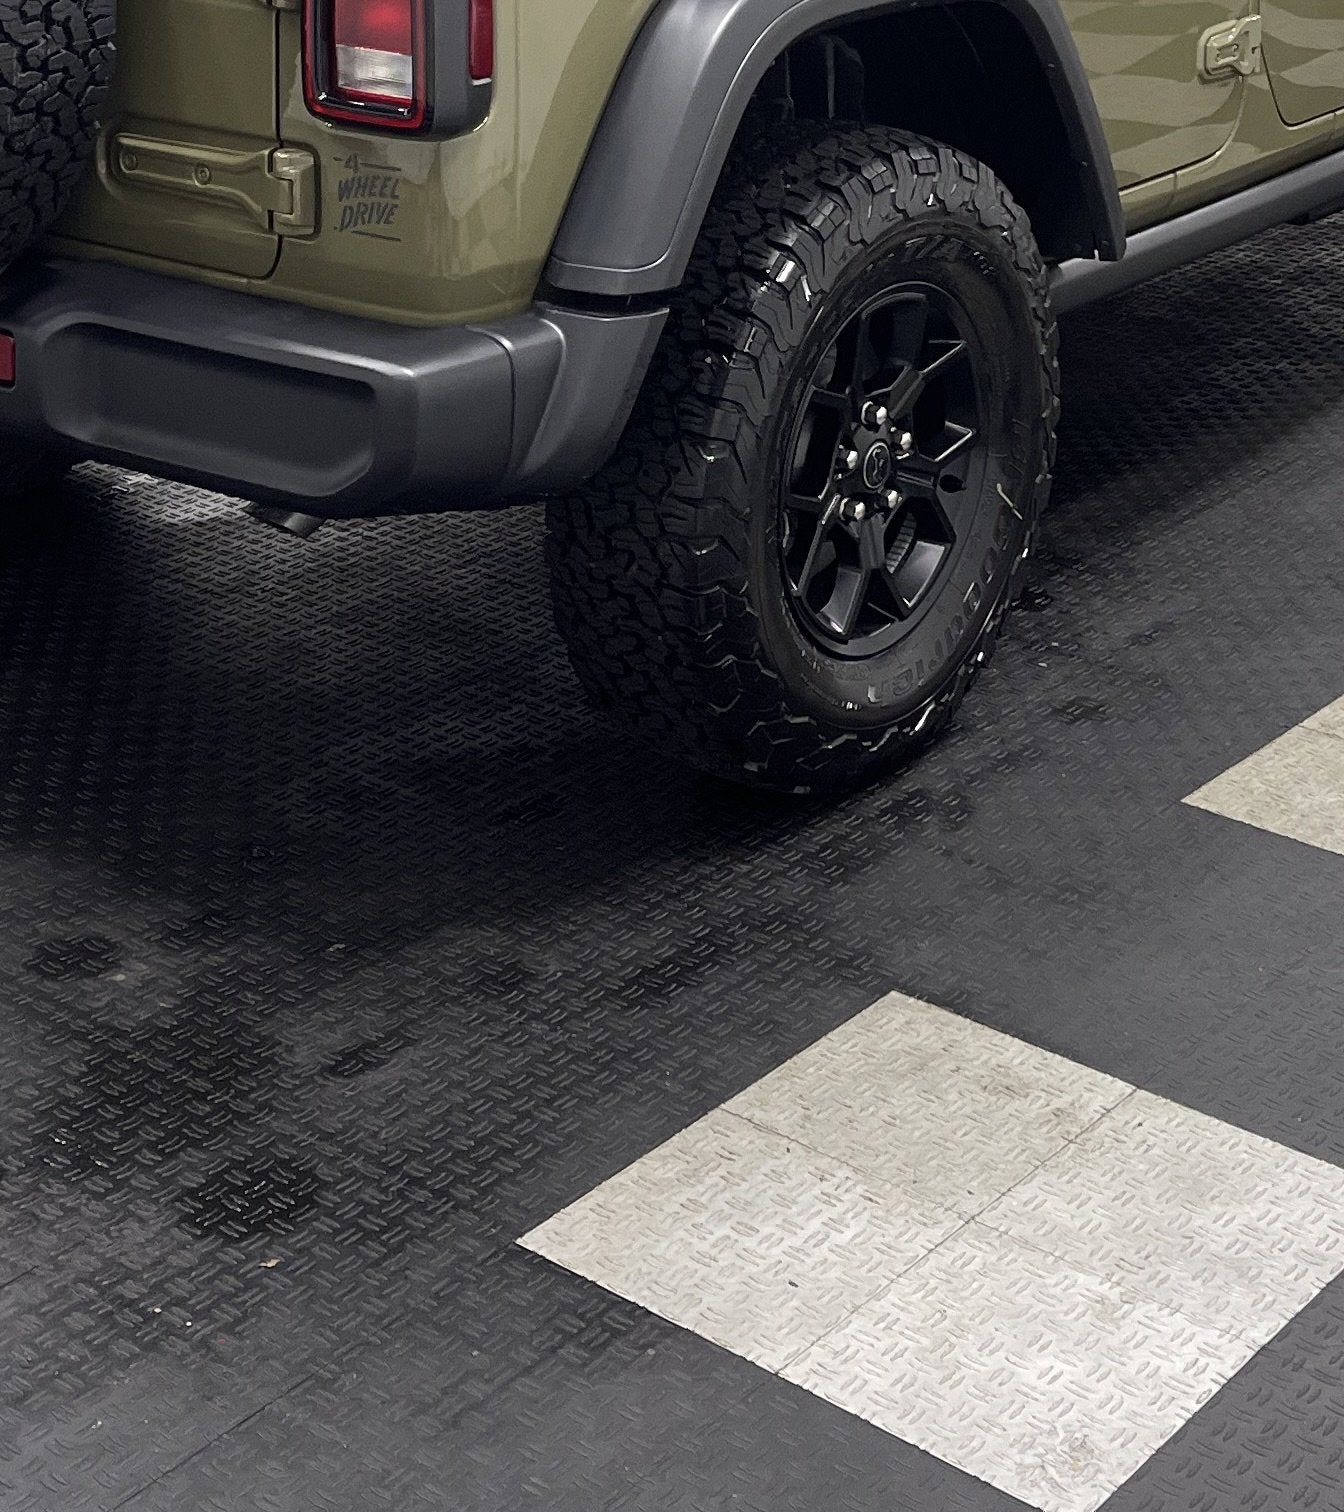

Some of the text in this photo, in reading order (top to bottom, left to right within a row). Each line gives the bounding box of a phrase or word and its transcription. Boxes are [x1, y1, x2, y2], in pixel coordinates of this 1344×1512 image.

[344, 153, 360, 174] 4
[338, 175, 400, 202] WHEEL
[339, 201, 400, 232] DRIVE
